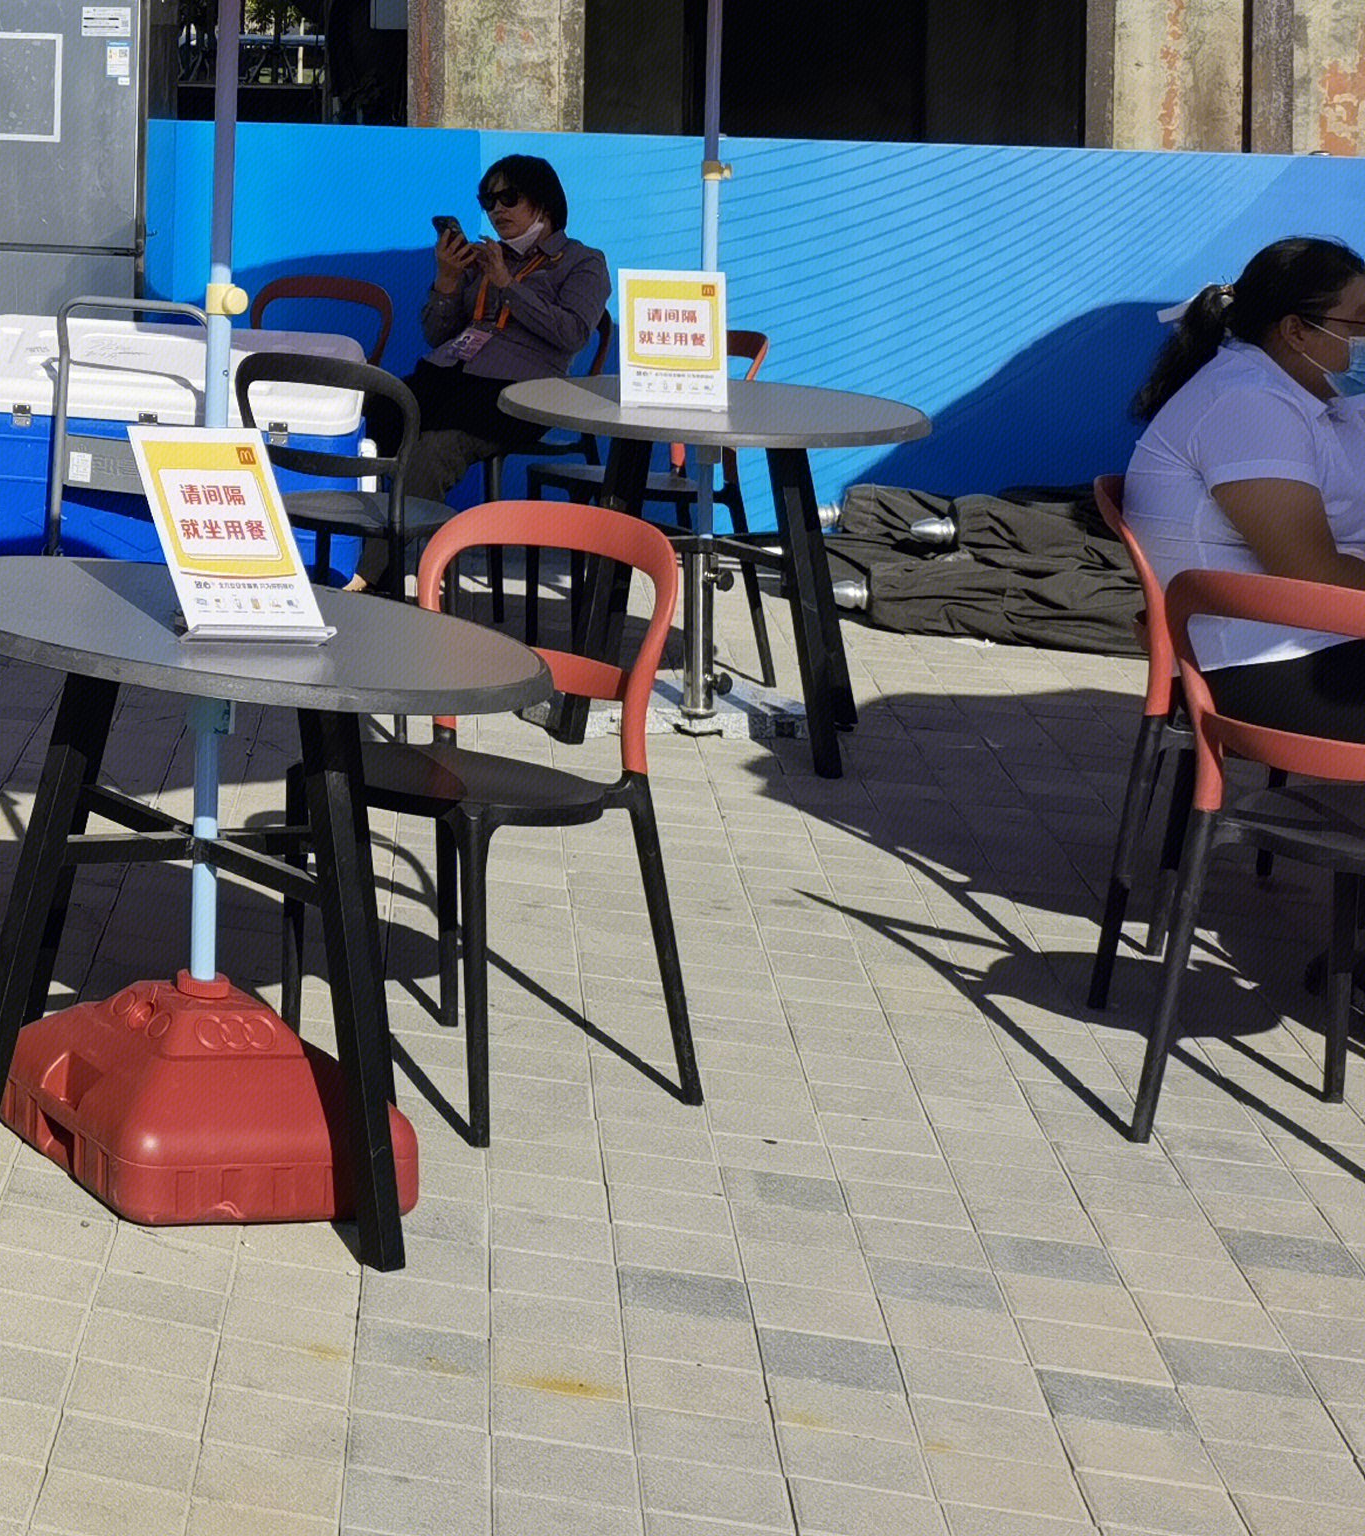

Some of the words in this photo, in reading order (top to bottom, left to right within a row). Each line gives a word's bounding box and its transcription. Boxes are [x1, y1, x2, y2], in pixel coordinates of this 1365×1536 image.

[647, 308, 697, 323] 请间隔
[638, 331, 705, 347] 就坐用餐
[180, 484, 246, 506] 请间隔
[180, 519, 267, 541] 就坐用餐
